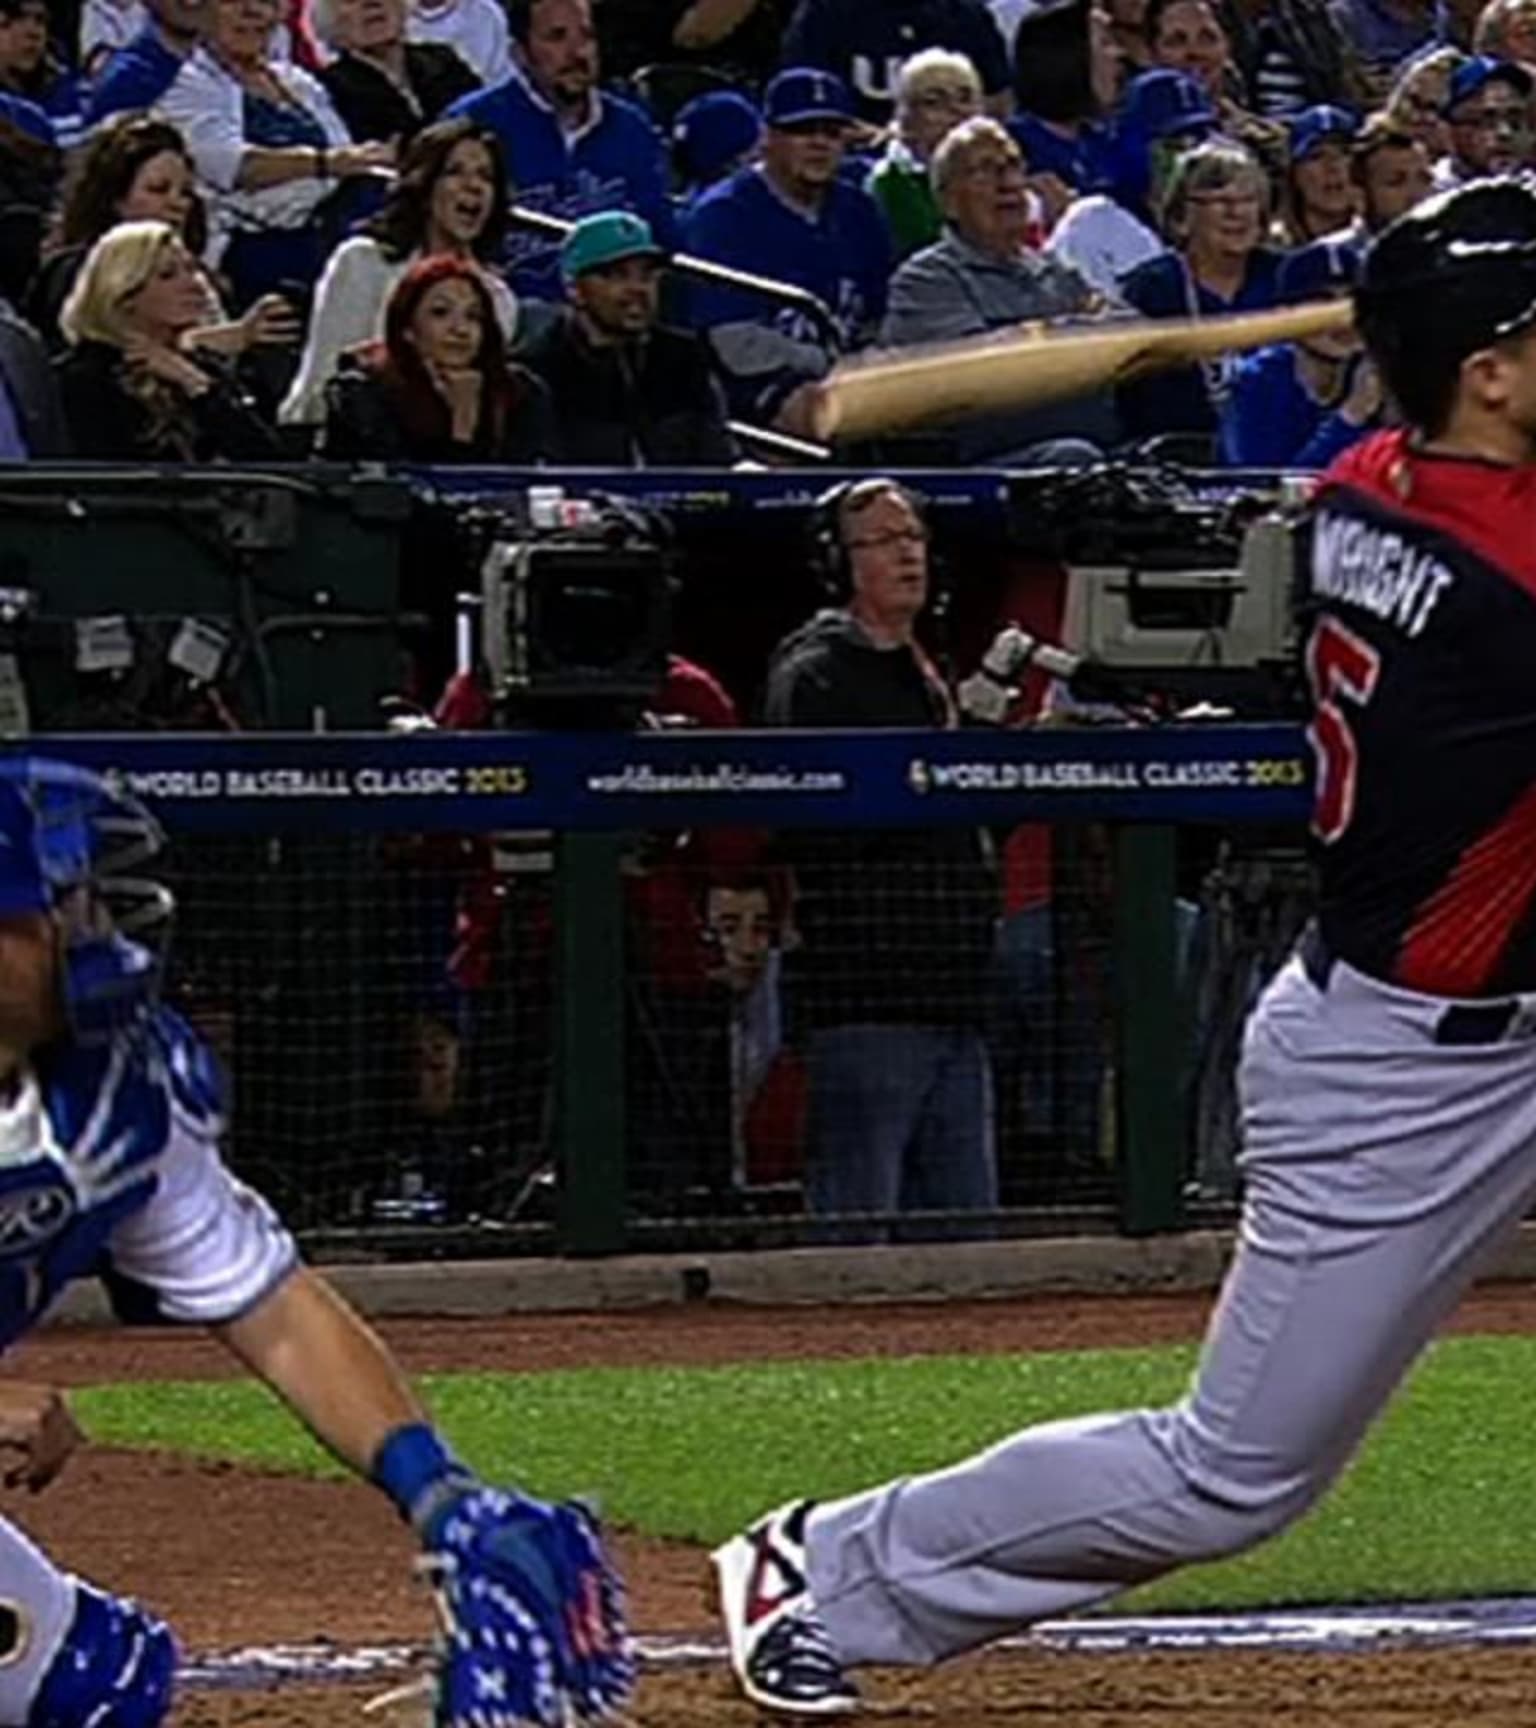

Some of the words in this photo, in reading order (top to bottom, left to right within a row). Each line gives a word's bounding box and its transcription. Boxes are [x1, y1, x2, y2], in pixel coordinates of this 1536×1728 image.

[1311, 508, 1456, 638] WRIGHT
[1305, 611, 1382, 846] 5
[227, 770, 350, 797] BASEBALL
[355, 767, 461, 795] CLASSIC
[933, 762, 1021, 788] WORLD
[1024, 762, 1140, 788] BASEBALL
[1144, 761, 1241, 787] CLASSIC
